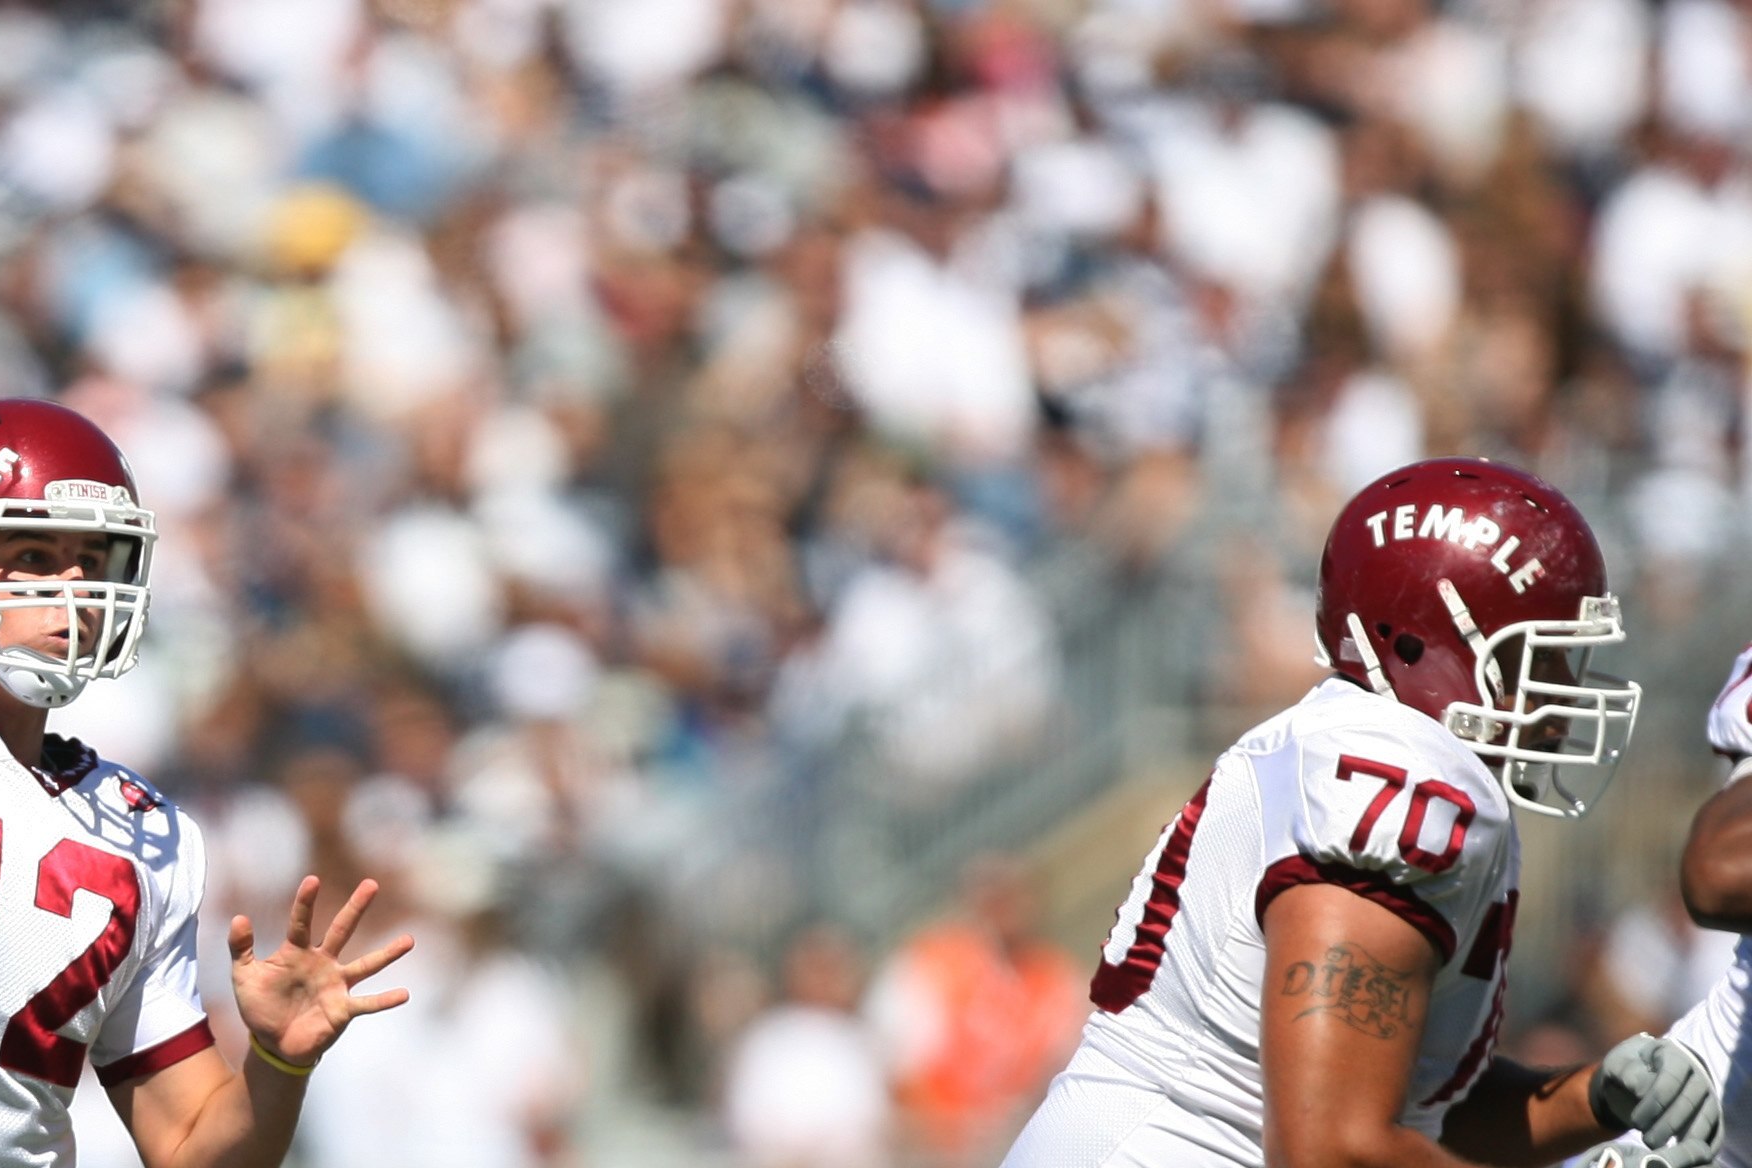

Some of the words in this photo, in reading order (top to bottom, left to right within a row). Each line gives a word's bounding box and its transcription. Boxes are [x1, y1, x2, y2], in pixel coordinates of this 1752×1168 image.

[68, 483, 107, 500] FINISH
[1367, 502, 1546, 594] TEMPLE
[1335, 753, 1476, 874] 70
